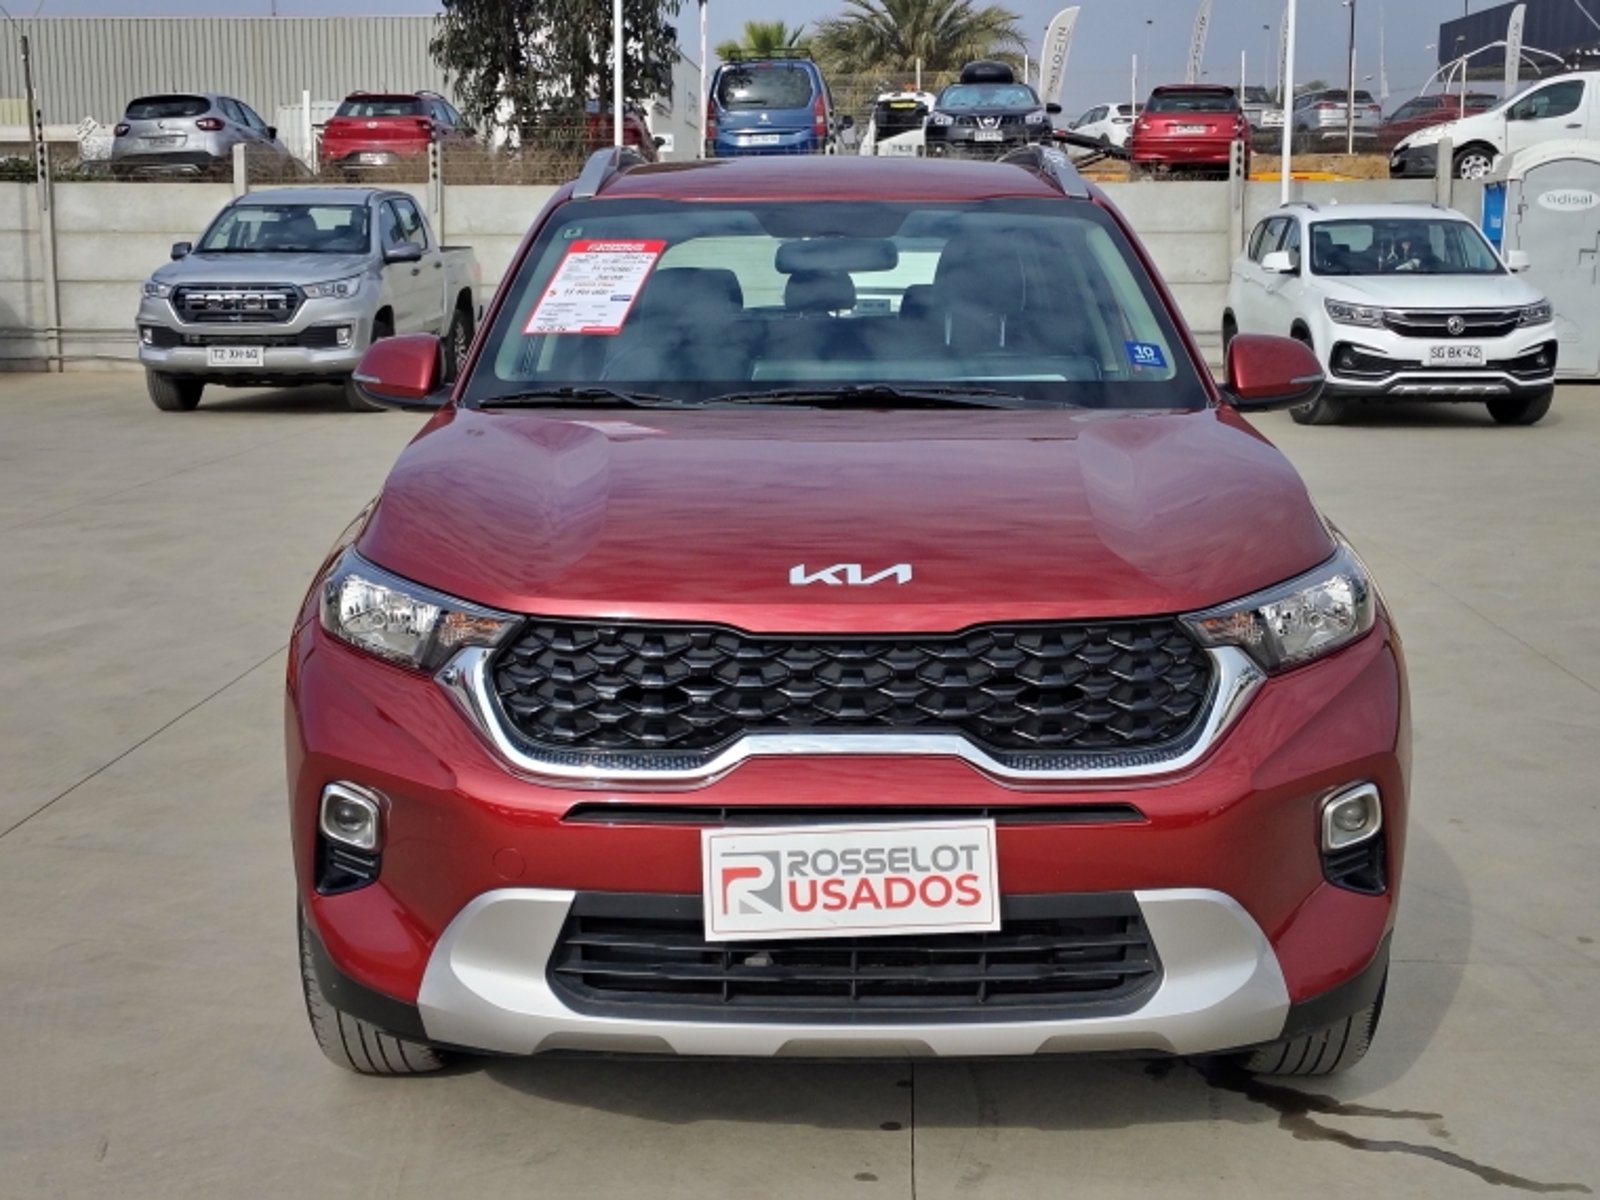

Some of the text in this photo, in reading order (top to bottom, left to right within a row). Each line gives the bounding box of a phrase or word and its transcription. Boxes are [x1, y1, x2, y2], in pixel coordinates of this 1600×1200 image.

[789, 563, 912, 585] KIA
[786, 844, 980, 877] ROSSELOT
[788, 873, 982, 912] USADOS
